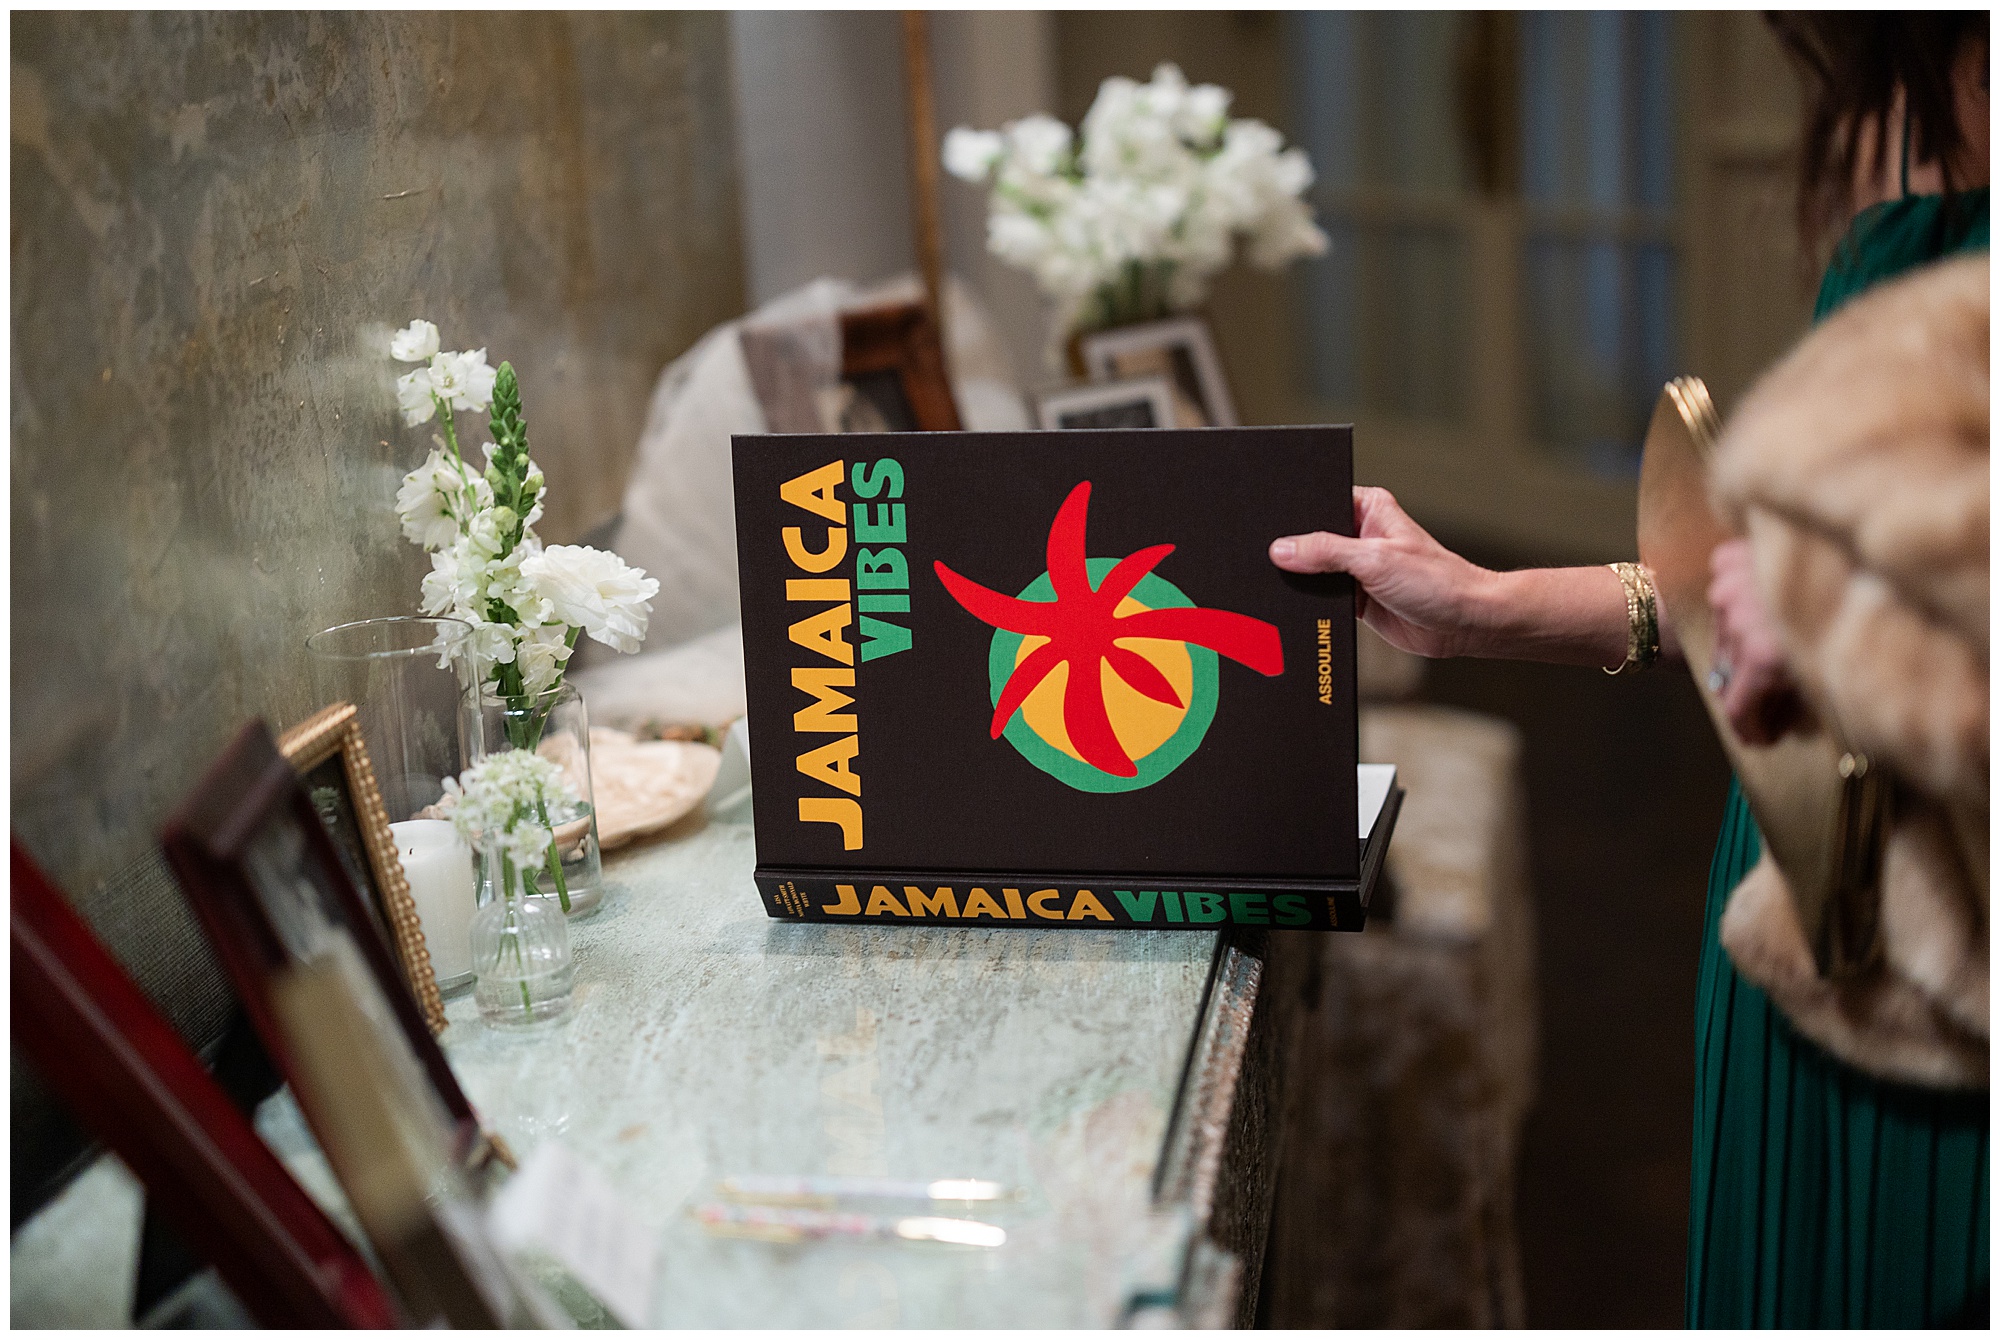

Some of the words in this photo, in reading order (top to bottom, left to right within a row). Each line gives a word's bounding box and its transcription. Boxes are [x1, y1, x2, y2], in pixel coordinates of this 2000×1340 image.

[851, 457, 913, 663] VIBES
[780, 459, 863, 851] JAMAICA
[1317, 619, 1332, 705] ASSOULINE
[822, 885, 1115, 921] JAMAICA
[1114, 891, 1312, 926] VIBES
